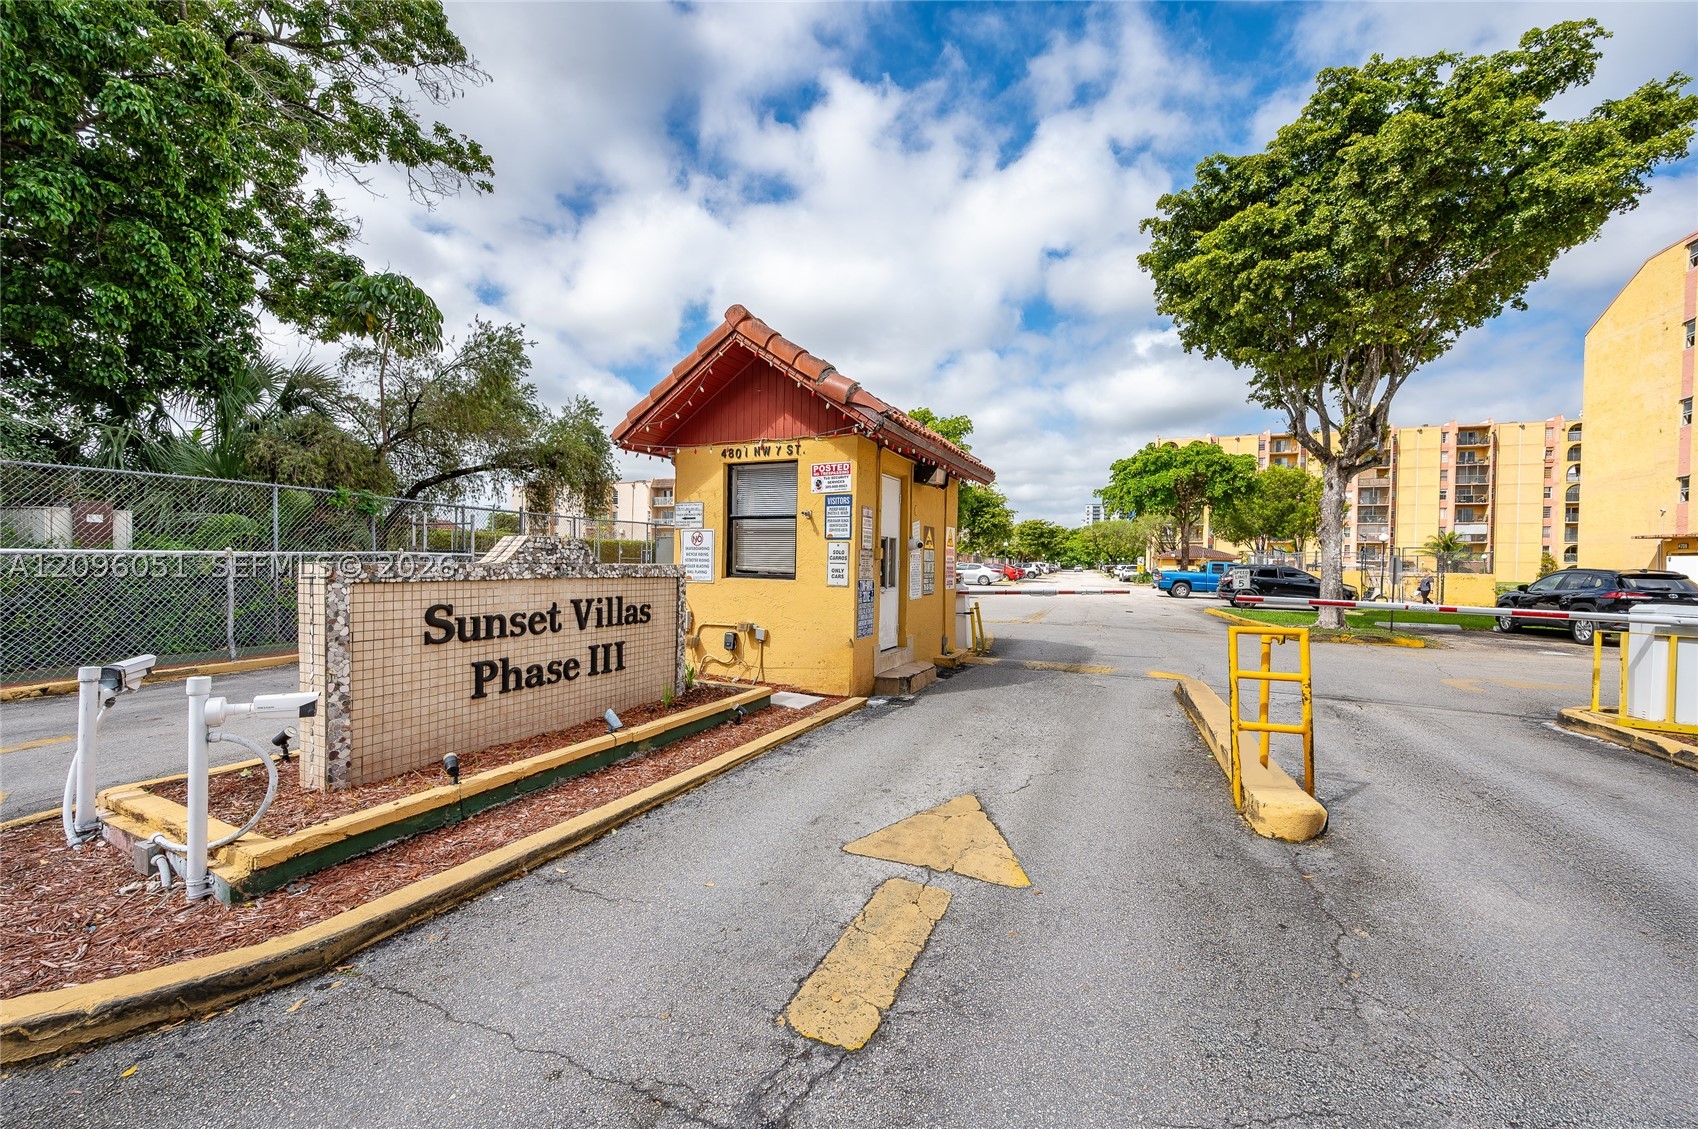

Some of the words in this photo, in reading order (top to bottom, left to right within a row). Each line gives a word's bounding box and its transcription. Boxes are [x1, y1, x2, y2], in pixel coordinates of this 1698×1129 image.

[721, 447, 748, 459] 4801
[754, 446, 771, 457] NW
[776, 446, 782, 456] 7
[813, 463, 850, 473] POSTED
[827, 497, 850, 505] VISITORS
[424, 601, 562, 646] Sunset
[570, 595, 652, 631] Villas
[471, 656, 580, 700] Phase
[587, 640, 626, 677] III
